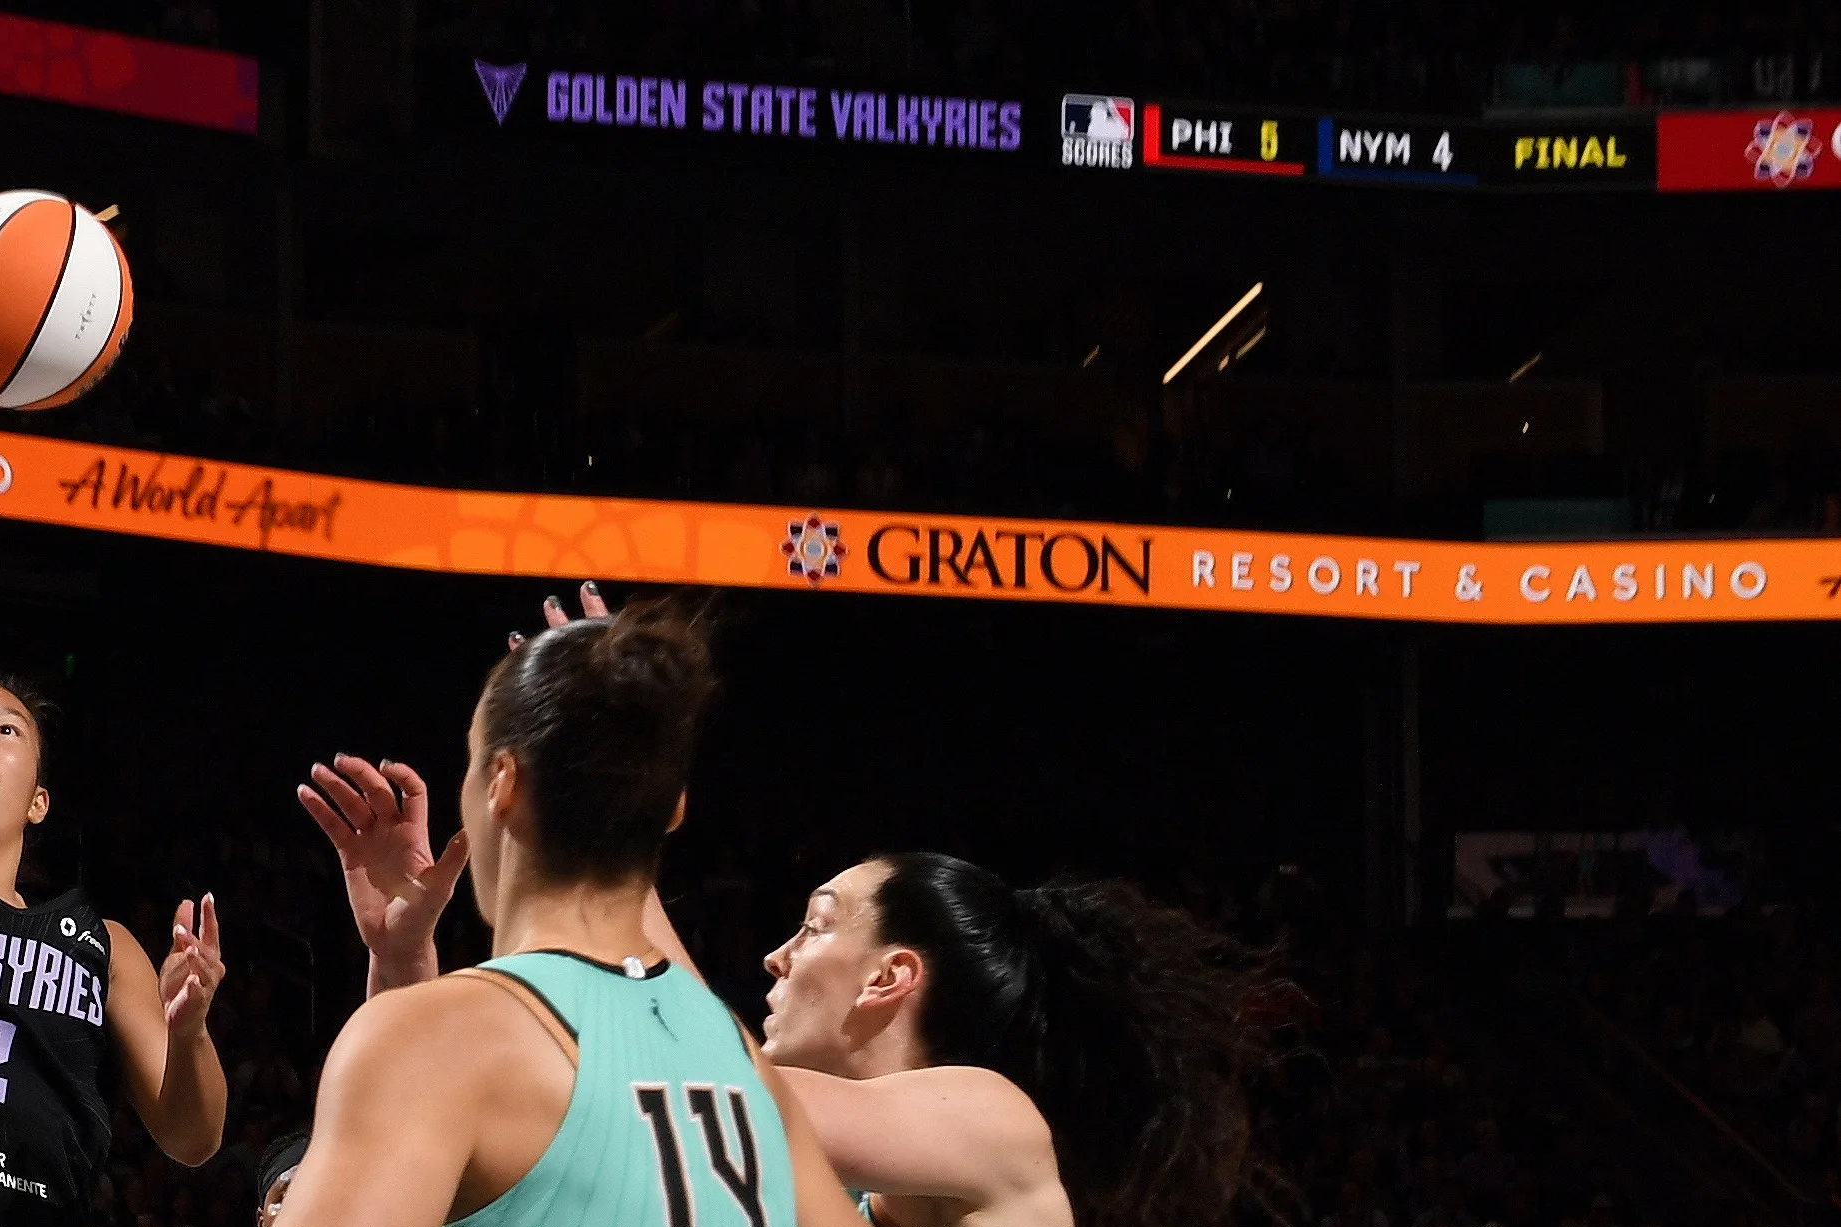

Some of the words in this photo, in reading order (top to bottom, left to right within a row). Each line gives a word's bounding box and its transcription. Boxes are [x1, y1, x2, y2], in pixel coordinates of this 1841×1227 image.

[547, 71, 687, 127] GOLDEN
[703, 81, 816, 138] STATE
[831, 90, 1022, 151] VALKYRIES
[1172, 117, 1233, 154] PHI
[1339, 128, 1411, 165] NYM
[1432, 131, 1453, 171] 4
[1514, 135, 1626, 171] FINAL
[59, 457, 106, 509] A
[111, 455, 227, 522] World
[865, 524, 1151, 596] GRATON
[1191, 549, 1421, 599] RESORT
[1454, 564, 1483, 602] &
[1520, 560, 1768, 604] CASINO
